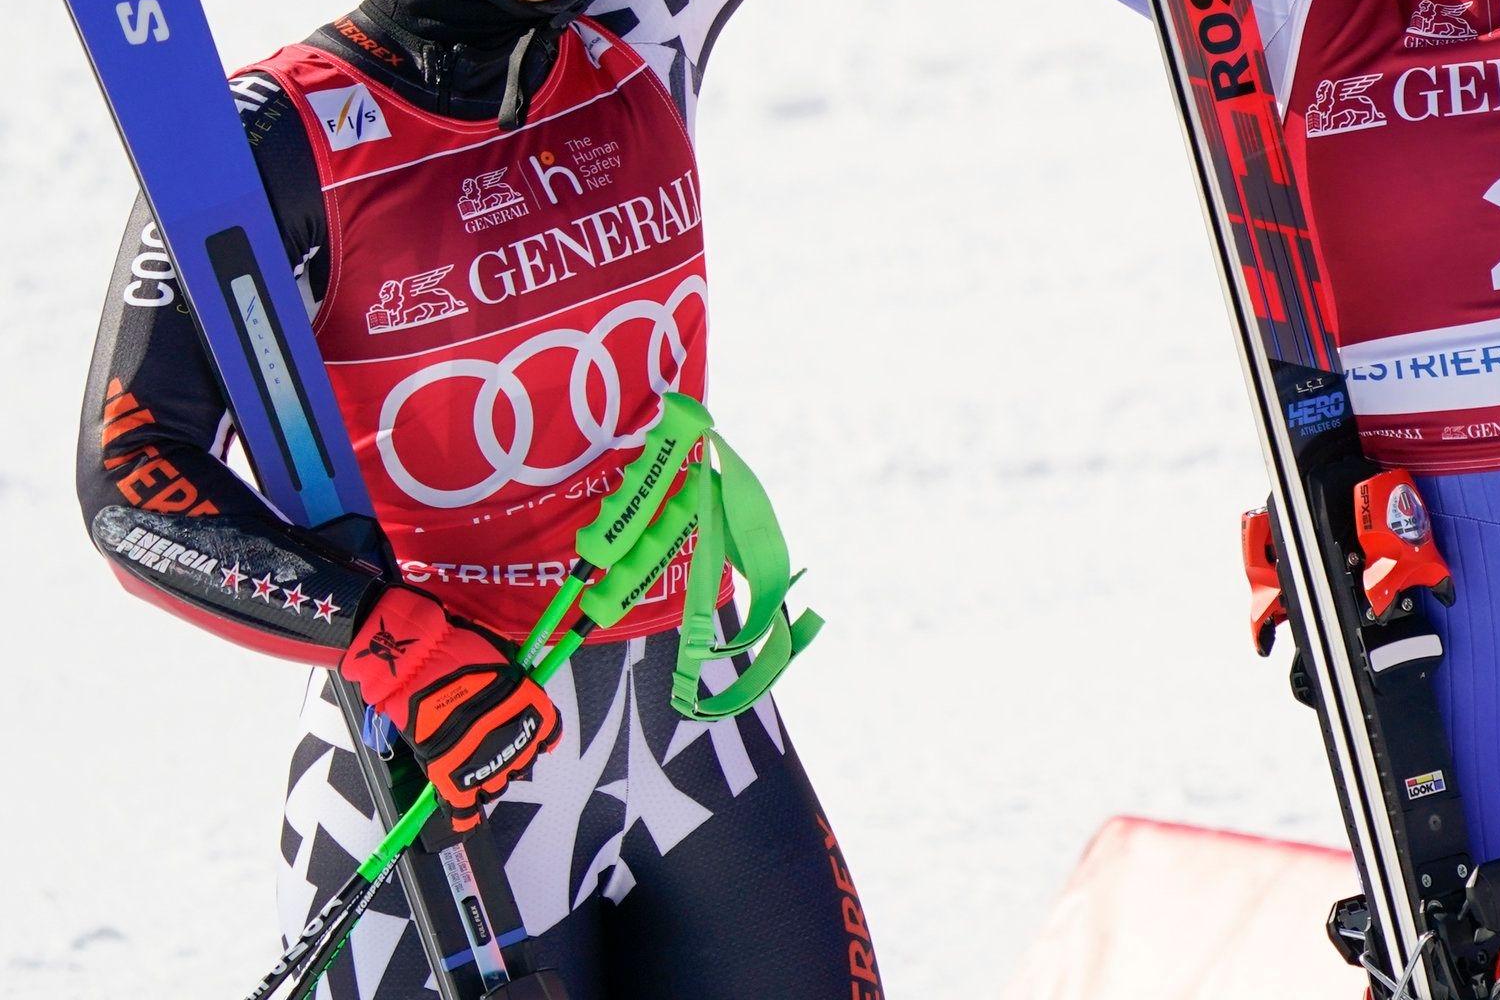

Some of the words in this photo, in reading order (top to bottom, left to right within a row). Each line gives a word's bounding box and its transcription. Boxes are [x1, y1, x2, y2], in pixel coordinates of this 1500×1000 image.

[565, 136, 593, 153] The
[572, 140, 619, 165] Human
[579, 154, 622, 179] Safety
[586, 173, 613, 191] Net
[465, 203, 530, 234] GENERALI
[1288, 391, 1345, 428] HERO
[1300, 421, 1332, 437] ATHLETE
[604, 437, 676, 545] KOMPERDELL
[463, 715, 537, 787] reusch
[1409, 781, 1434, 797] LOOK
